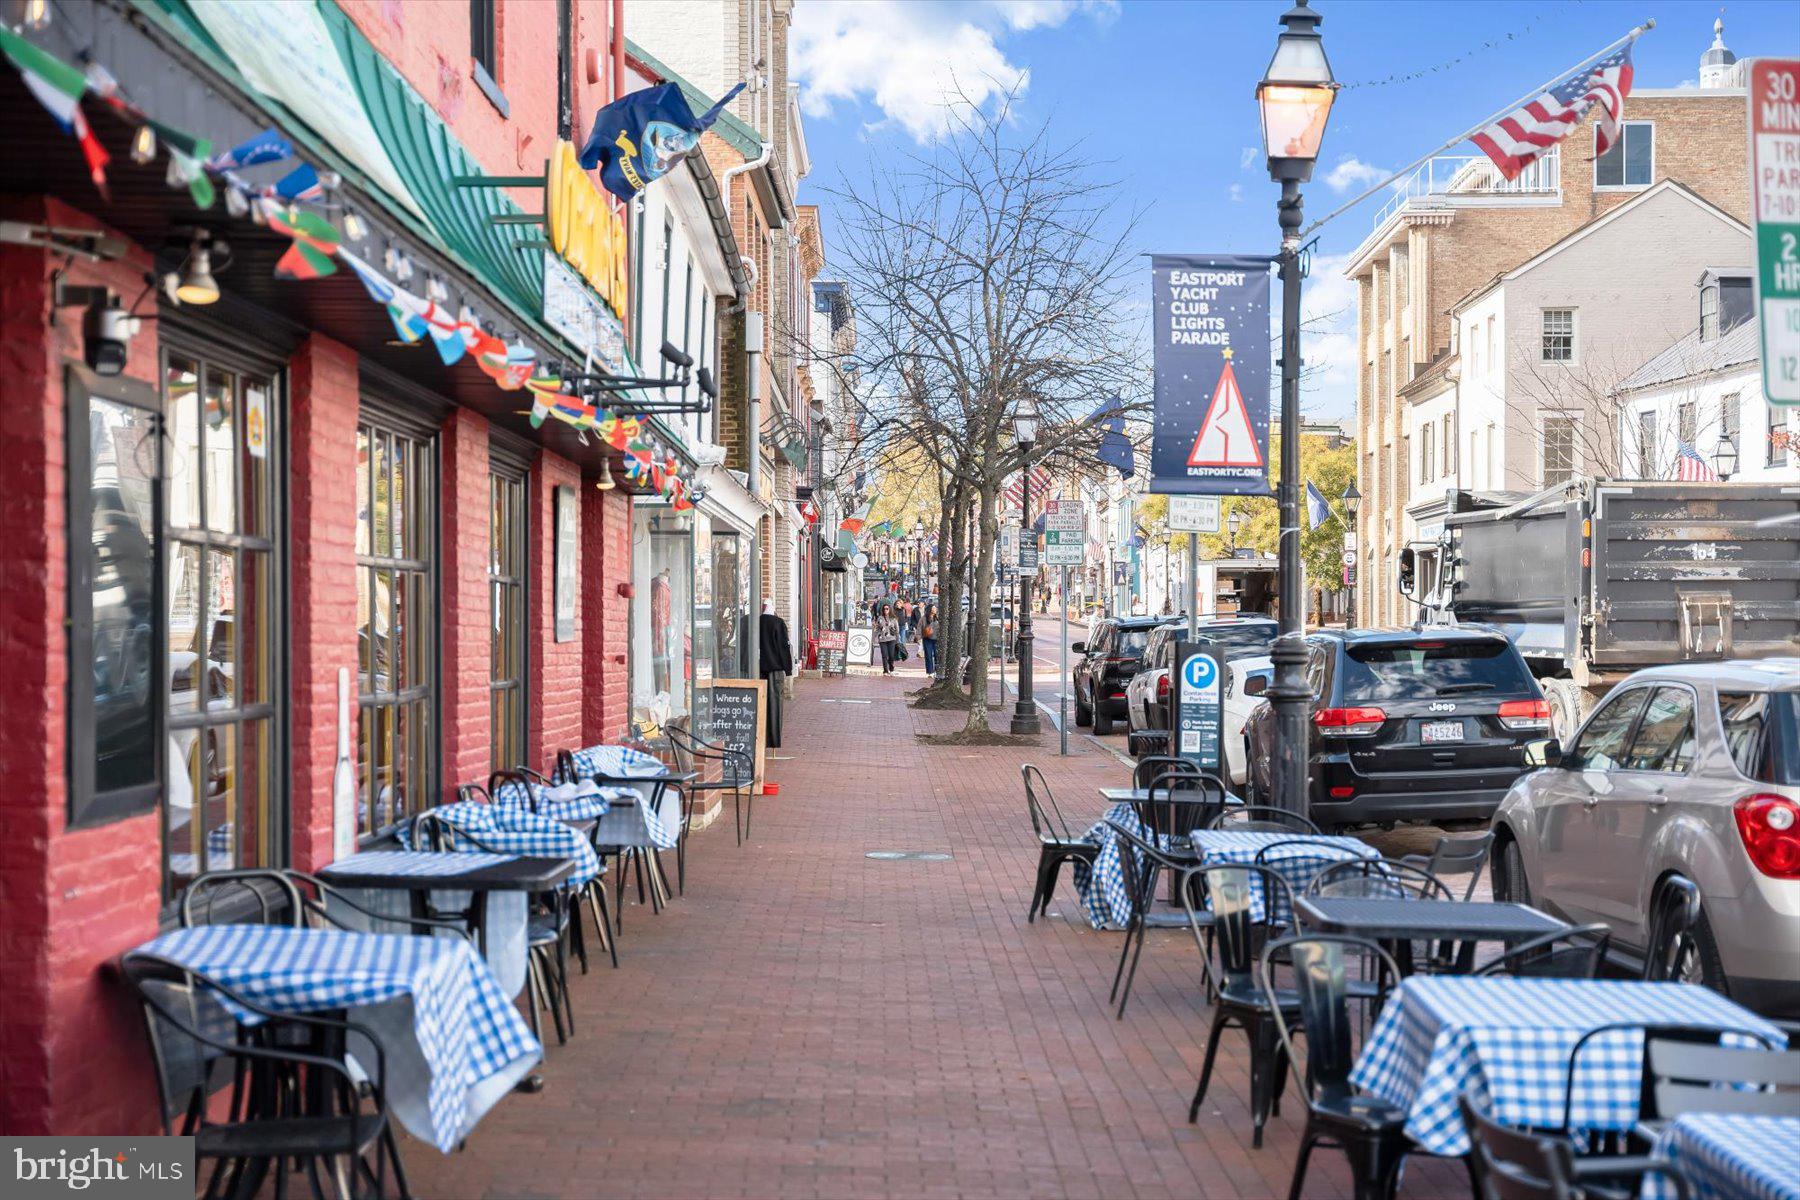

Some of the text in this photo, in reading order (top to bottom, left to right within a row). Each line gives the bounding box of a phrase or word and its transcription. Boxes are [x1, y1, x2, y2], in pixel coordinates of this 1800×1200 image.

[1766, 72, 1796, 100] 30
[1762, 102, 1800, 129] MIN
[1780, 231, 1797, 262] 2
[1170, 270, 1246, 286] EASTPORT
[1170, 287, 1219, 300] YACHT
[1170, 302, 1209, 315] CLUB
[1171, 316, 1225, 330] LIGHTS
[1171, 331, 1230, 345] PARADE
[1187, 467, 1263, 477] EASTPORTYC.ORG
[1193, 662, 1209, 683] P
[716, 694, 740, 703] Where
[742, 694, 752, 703] do
[712, 705, 742, 718] dogs go
[1429, 702, 1456, 712] Jeep
[712, 720, 733, 730] after
[734, 720, 753, 730] their
